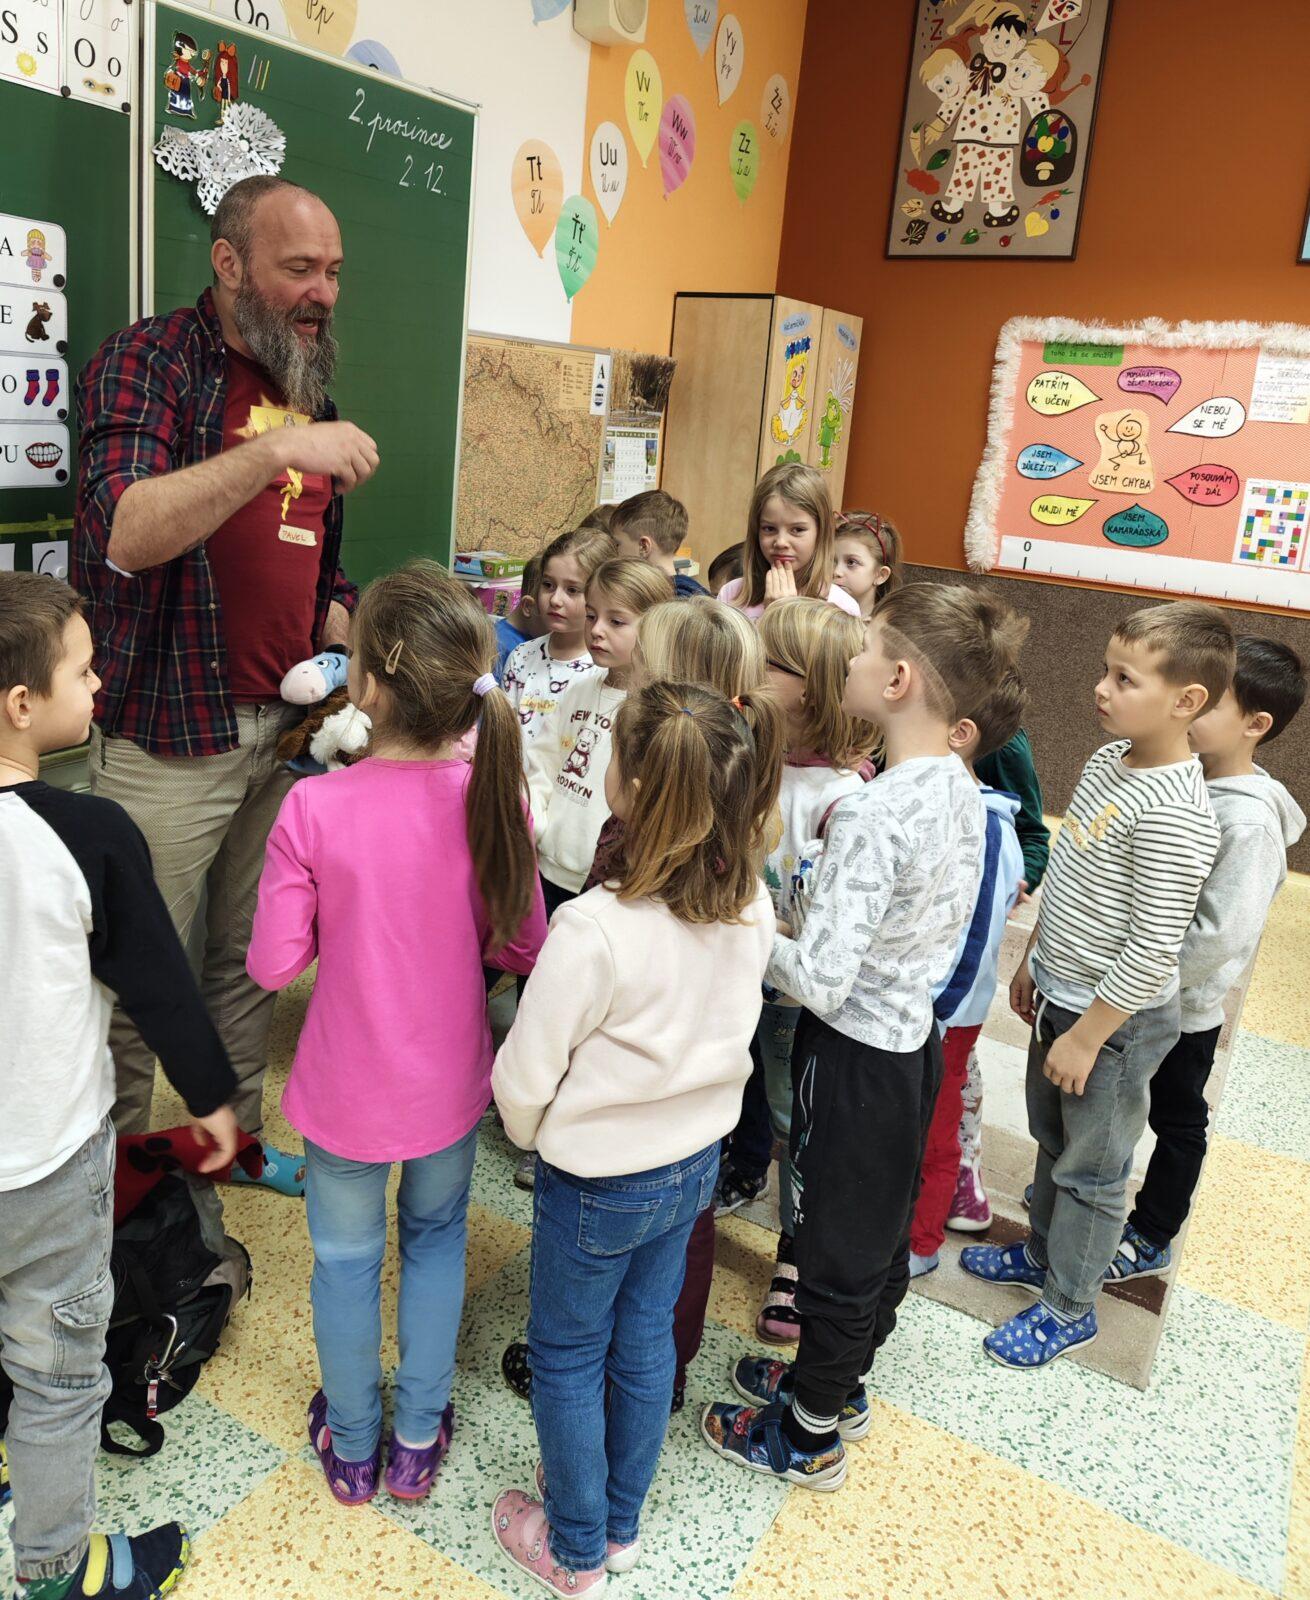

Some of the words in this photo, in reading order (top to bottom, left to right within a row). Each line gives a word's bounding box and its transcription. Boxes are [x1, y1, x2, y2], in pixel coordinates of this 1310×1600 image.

[1, 10, 18, 43] S
[37, 31, 49, 54] s
[930, 18, 944, 41] Z
[74, 38, 96, 68] O
[107, 57, 121, 77] o
[636, 70, 650, 93] Vv
[348, 88, 364, 124] 2.
[366, 111, 453, 152] prosince
[599, 142, 617, 166] Uu
[526, 155, 543, 182] Tt
[0, 236, 14, 256] A
[2, 374, 17, 393] O
[1034, 375, 1069, 391] PATŘÍM
[1031, 395, 1038, 404] K
[1045, 394, 1072, 407] UČENÍ
[1200, 405, 1231, 416] NEBOJ
[1192, 419, 1206, 429] SE
[1212, 418, 1228, 430] MĚ
[1031, 450, 1053, 458] JSEM
[1092, 474, 1117, 487] JSEM
[1121, 476, 1151, 490] CHYBA
[1205, 485, 1222, 496] DÁL
[1038, 504, 1062, 515] NAJDI
[1065, 506, 1080, 517] MĚ
[1122, 513, 1145, 522] JSEM
[1107, 524, 1163, 537] KAMARÁDSKÁ
